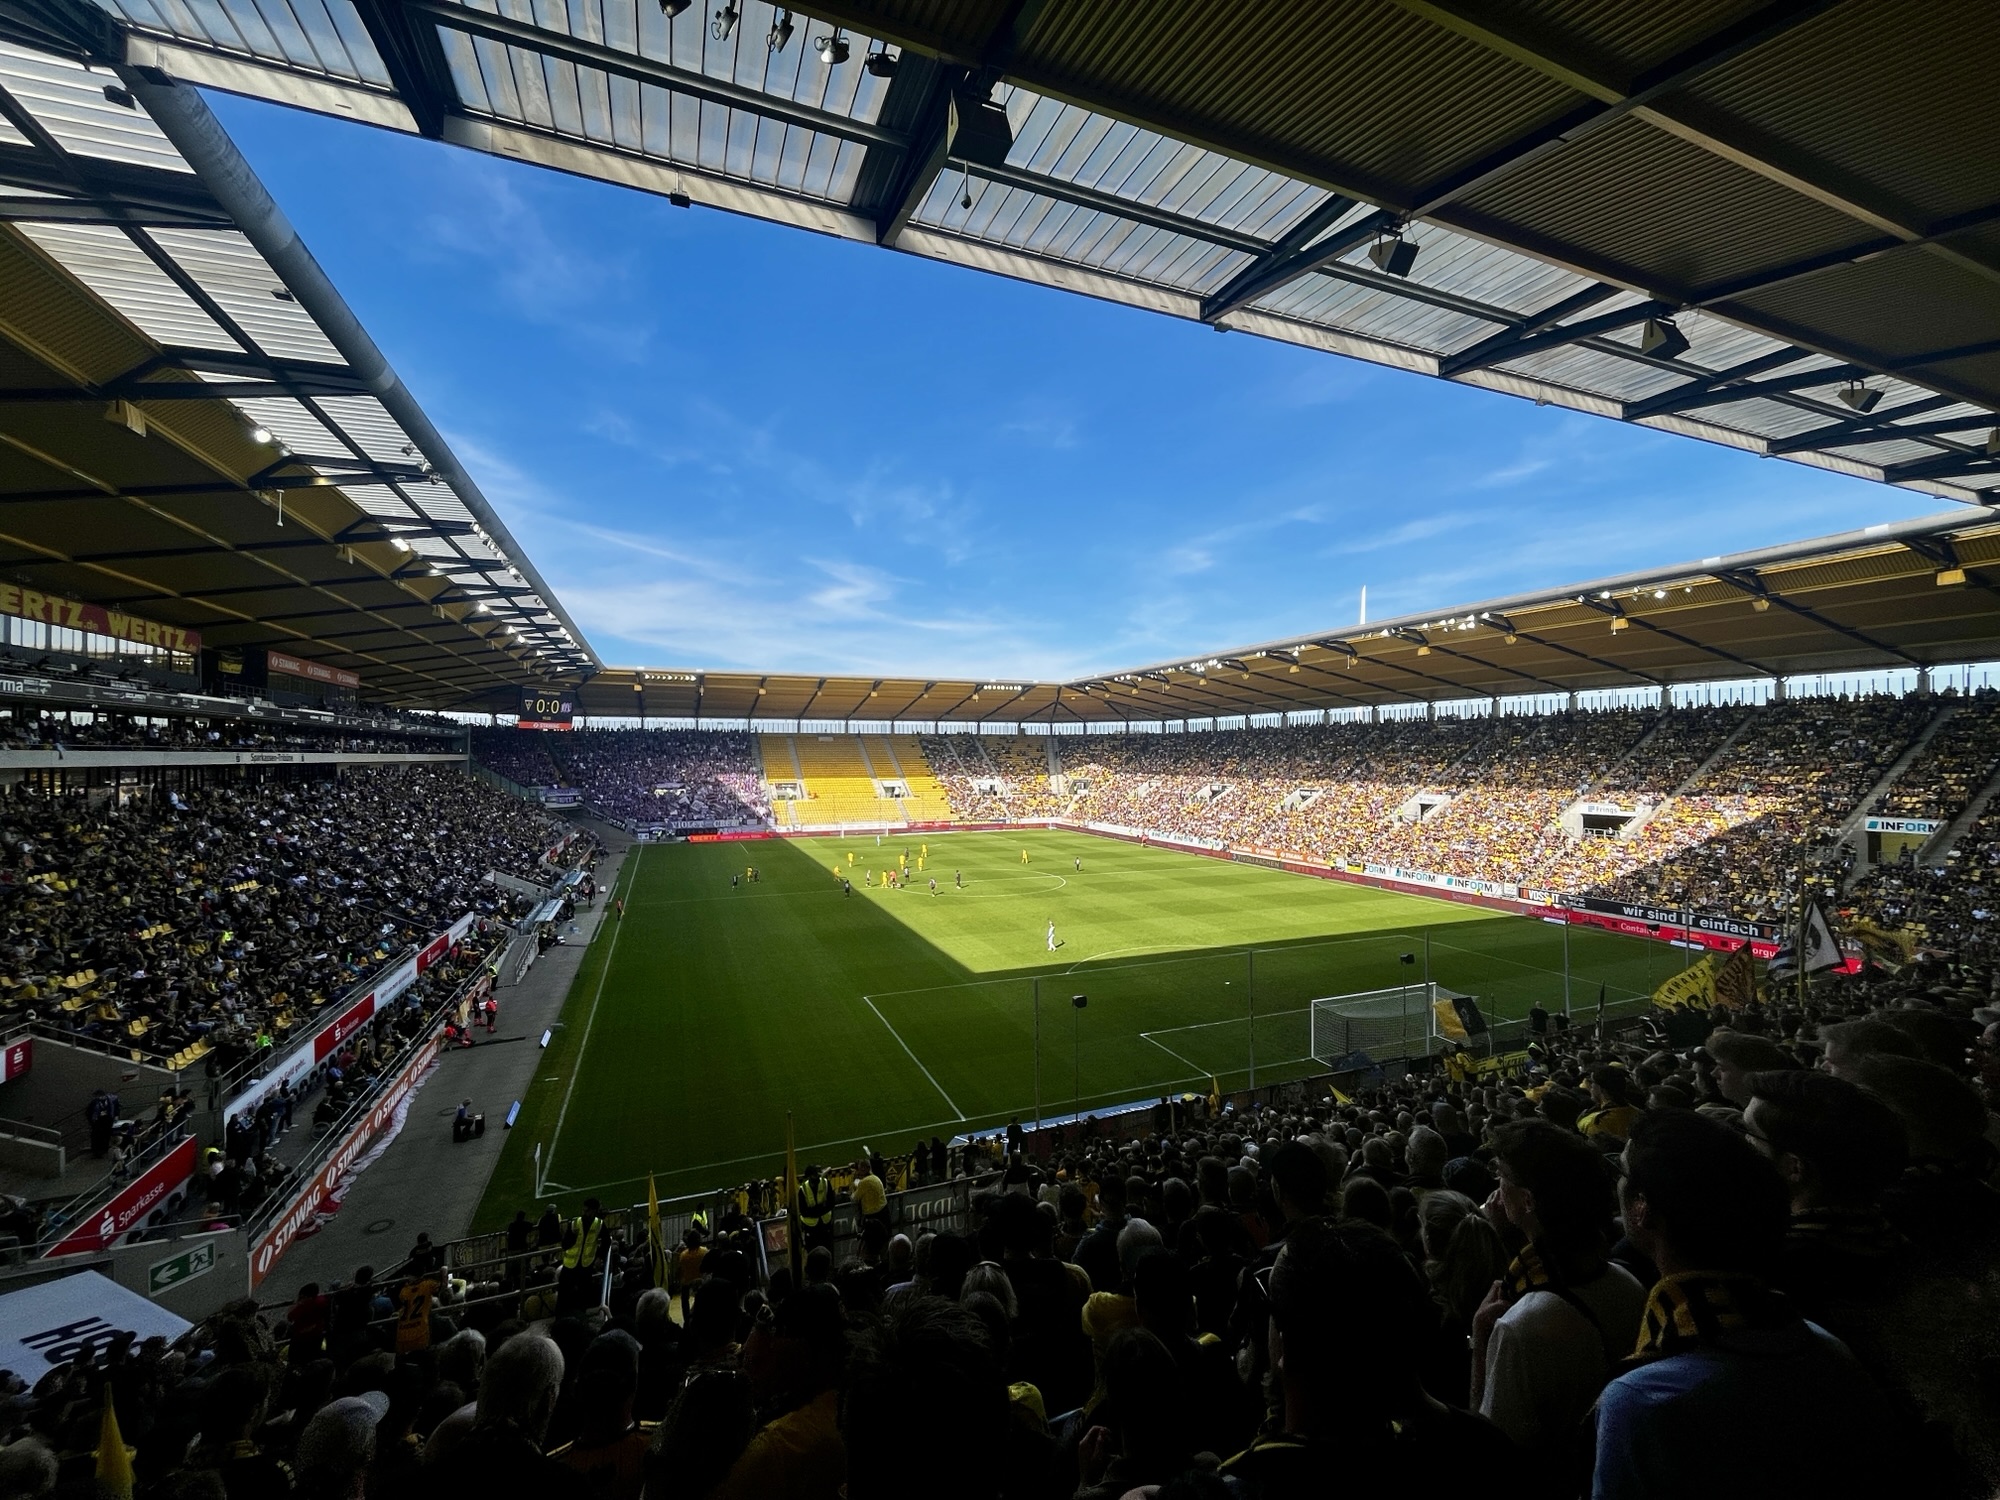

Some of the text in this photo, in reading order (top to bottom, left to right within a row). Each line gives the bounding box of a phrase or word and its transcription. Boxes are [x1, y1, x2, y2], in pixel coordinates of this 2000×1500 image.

[671, 820, 704, 829] VIOLET
[1881, 821, 1939, 833] INFORM
[1364, 864, 1386, 875] FORM
[1402, 870, 1436, 883] INFORM
[1454, 878, 1493, 893] INFORM
[1623, 906, 1644, 918] wir
[1647, 909, 1677, 924] sind
[1700, 918, 1759, 937] einfach
[382, 1076, 410, 1119] STAWAG
[337, 1122, 370, 1176] STAWAG
[119, 1182, 165, 1229] Sparkasse
[275, 1184, 321, 1256] STAWAG
